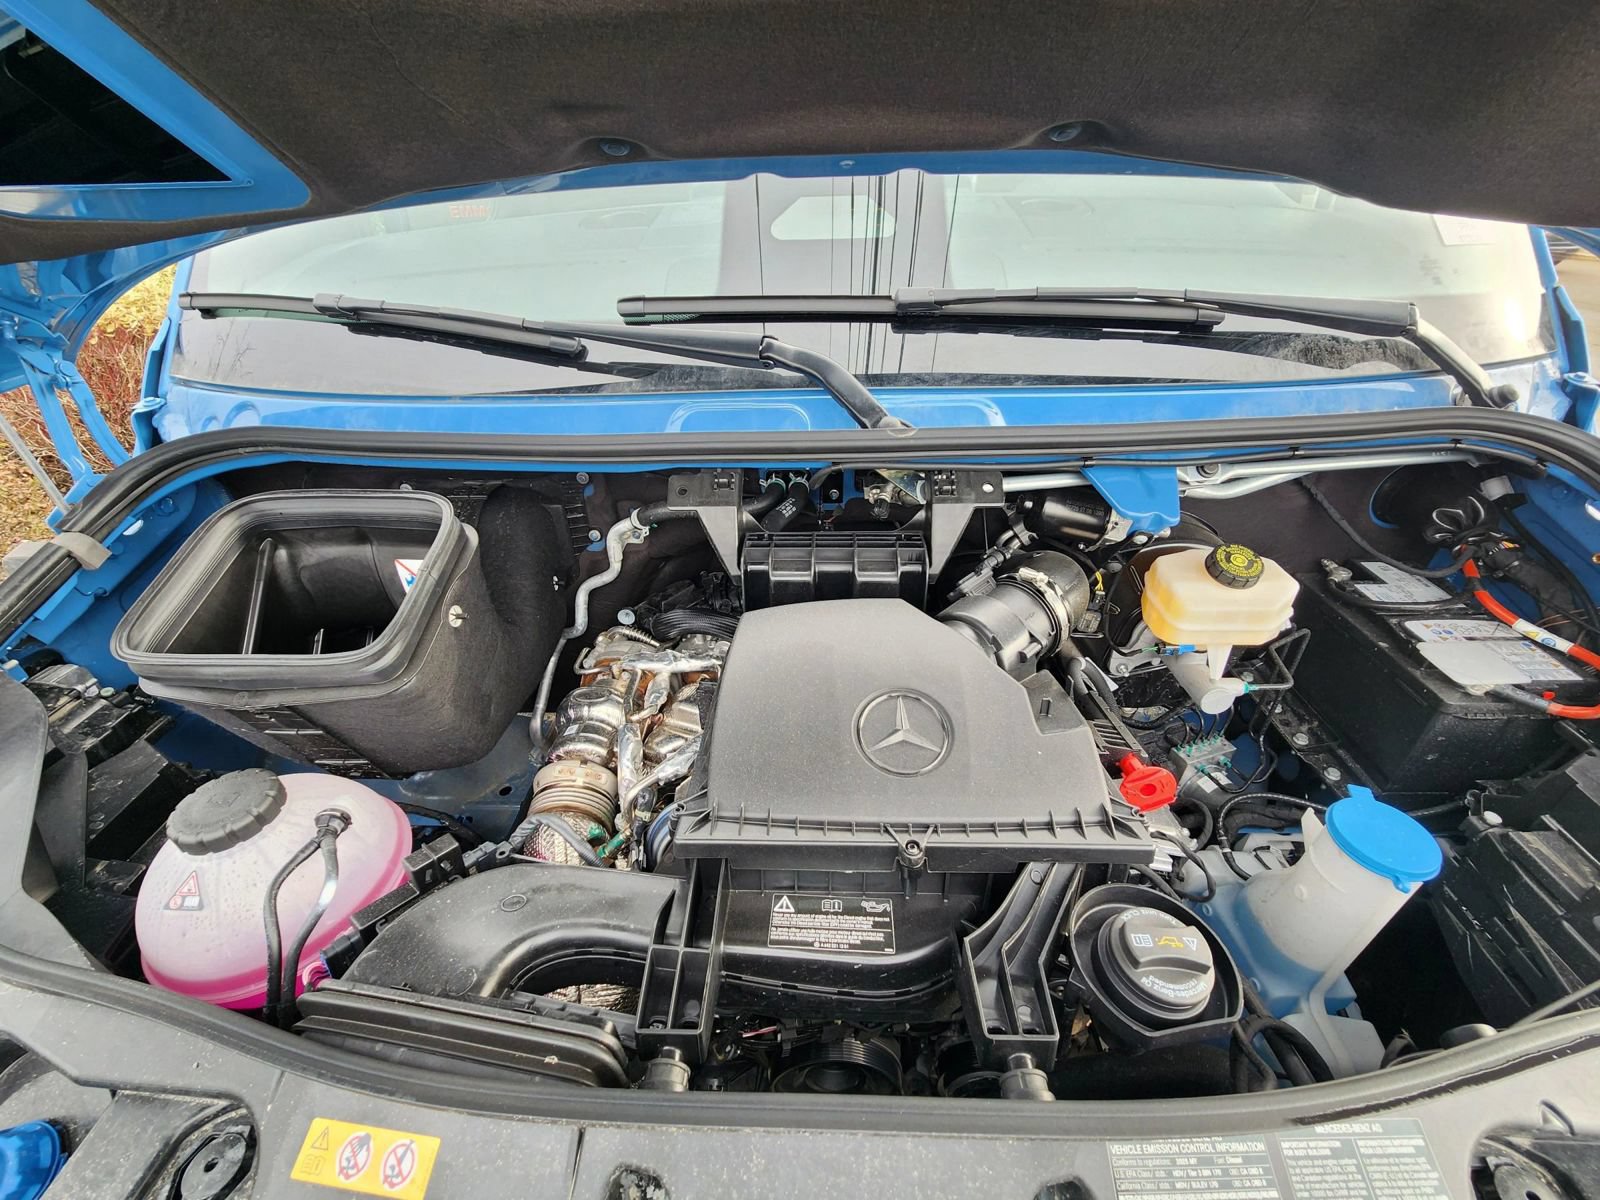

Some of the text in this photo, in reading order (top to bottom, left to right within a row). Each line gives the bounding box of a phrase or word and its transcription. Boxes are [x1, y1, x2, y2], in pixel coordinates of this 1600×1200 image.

[1120, 910, 1139, 922] CLICK
[1160, 912, 1177, 925] Turn
[1140, 976, 1207, 998] Mercedes-Benz Oil
[1149, 975, 1198, 990] recommended
[1314, 1123, 1384, 1134] MERCEDES-BENZ AG
[1110, 1142, 1265, 1154] VEHICLE EMISSION CONTROL INFORMATION
[1226, 1156, 1243, 1164] Diesel
[1126, 1170, 1137, 1178] EPA
